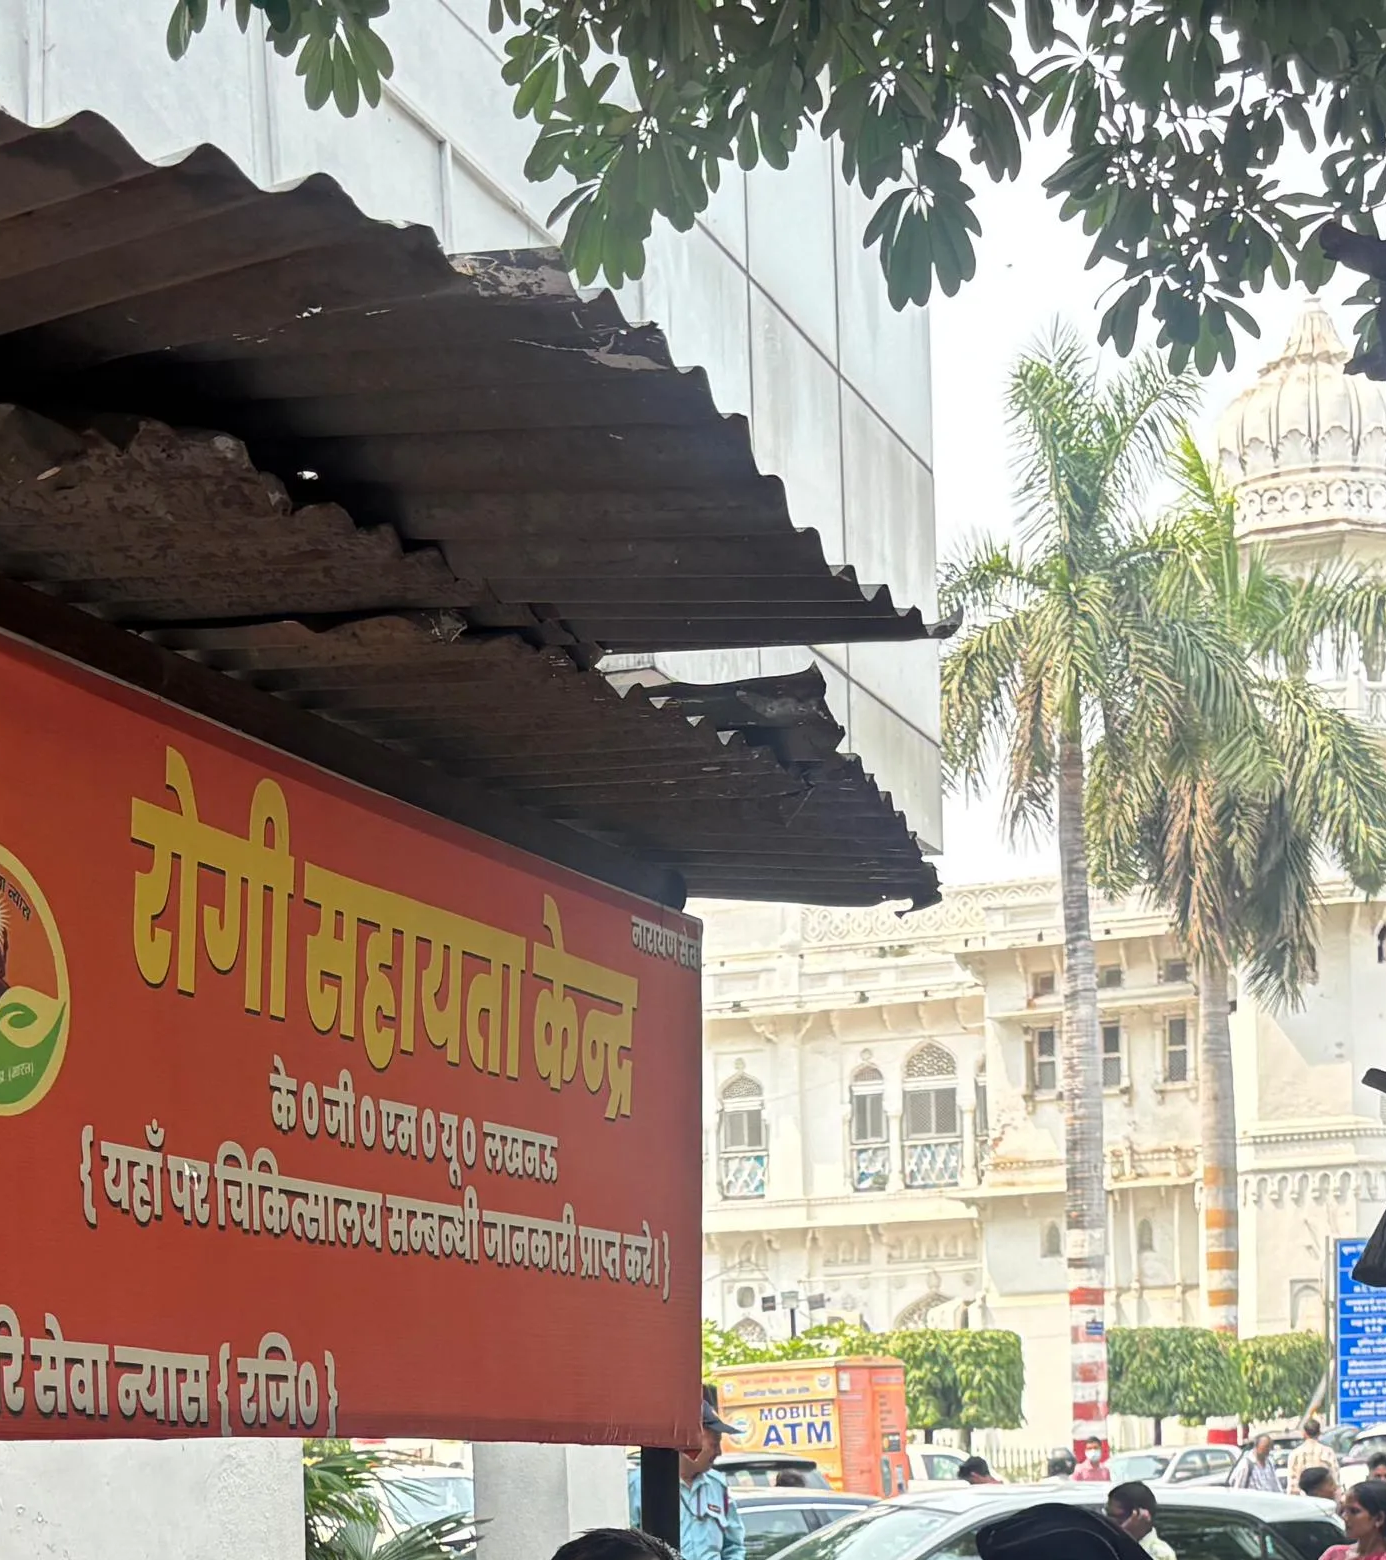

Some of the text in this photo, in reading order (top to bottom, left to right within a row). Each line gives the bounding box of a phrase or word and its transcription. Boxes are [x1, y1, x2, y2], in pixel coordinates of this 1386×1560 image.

[131, 745, 639, 1121] रोगी सहायता केन्द्र
[481, 1120, 562, 1187] लखनऊ
[101, 1120, 164, 1223] यहाँ
[166, 1154, 211, 1225] पर
[213, 1140, 384, 1249] चिकित्सालय
[385, 1184, 481, 1265] सम्बन्धी
[482, 1202, 576, 1277] जानकारी
[578, 1218, 622, 1283] प्राप्त
[30, 1312, 110, 1416] सेवा
[113, 1345, 210, 1423] न्यास
[759, 1403, 832, 1422] MOBILE
[763, 1420, 832, 1447] ATM
